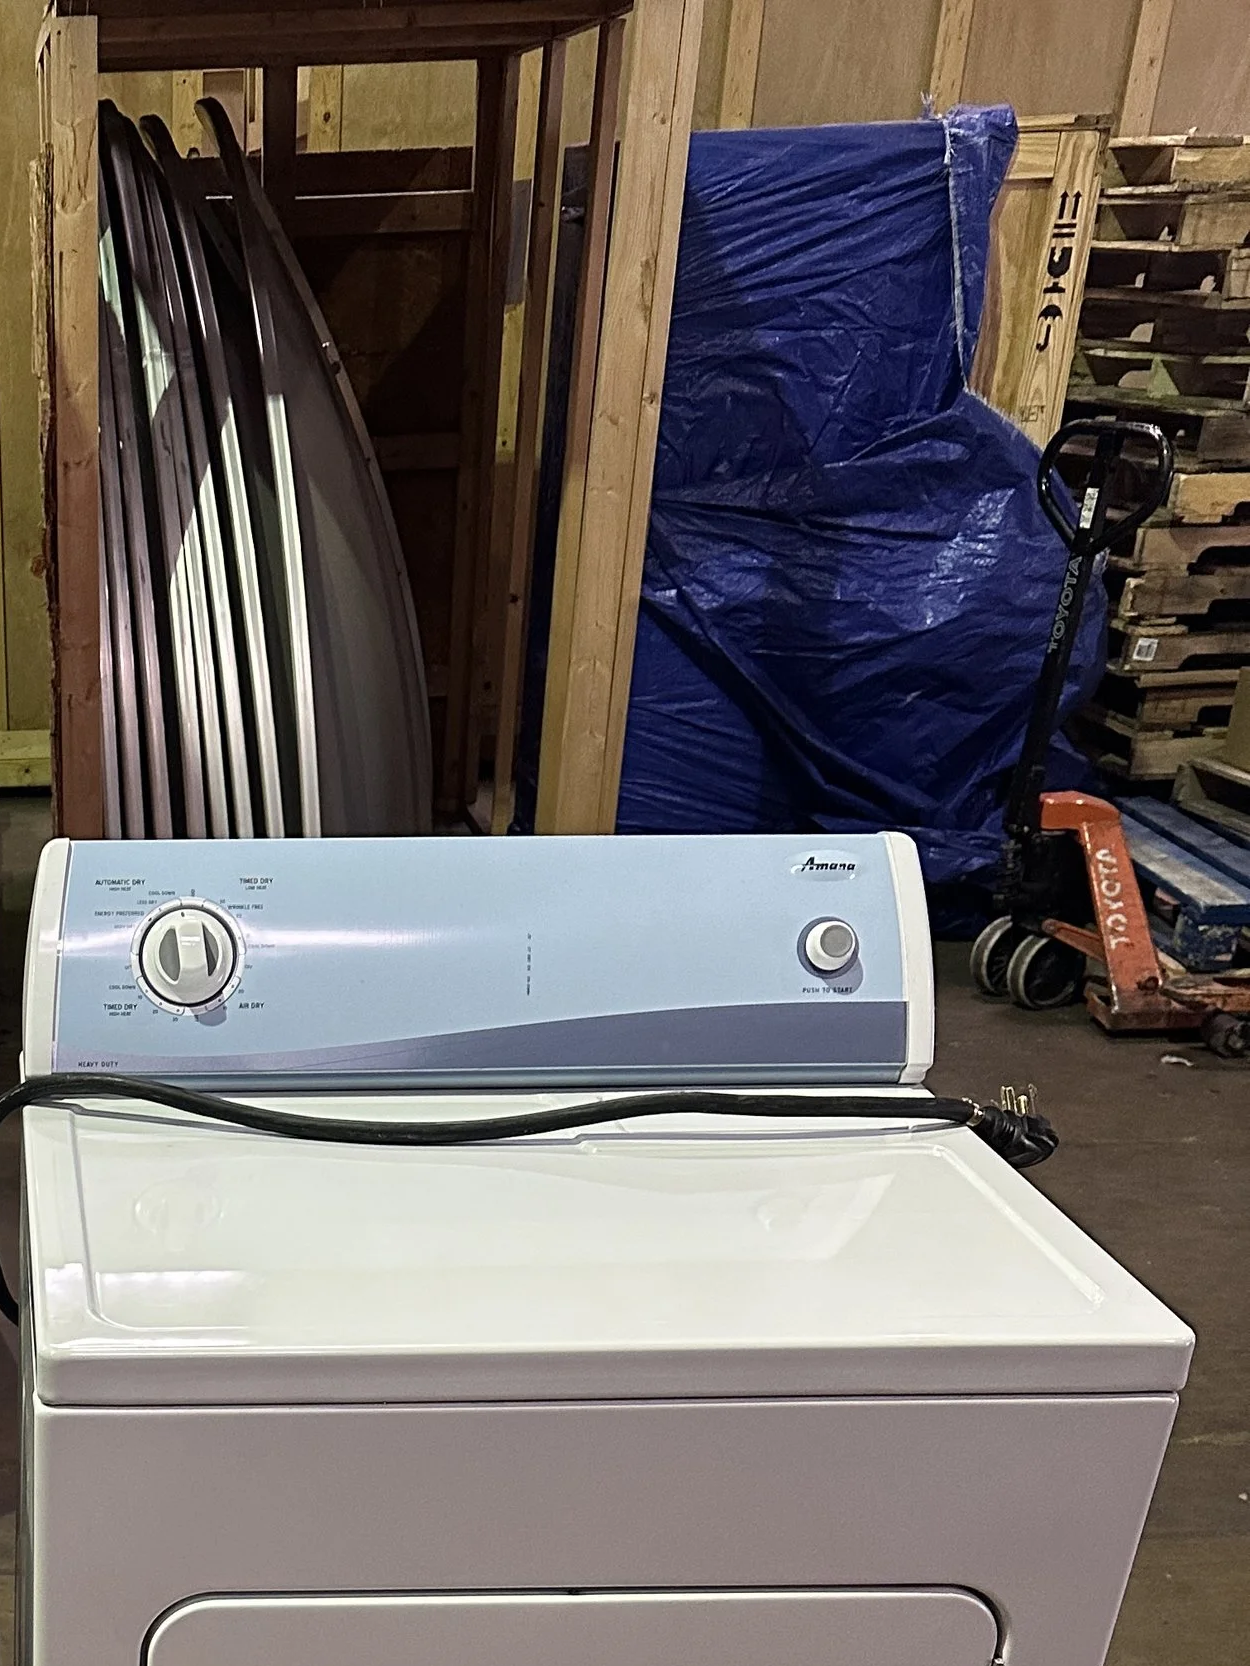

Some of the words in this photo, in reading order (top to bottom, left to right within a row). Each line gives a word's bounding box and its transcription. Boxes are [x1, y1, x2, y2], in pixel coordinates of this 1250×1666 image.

[1047, 556, 1082, 653] TOYOTA
[801, 856, 855, 872] Amana
[1095, 848, 1130, 949] TOYOTA
